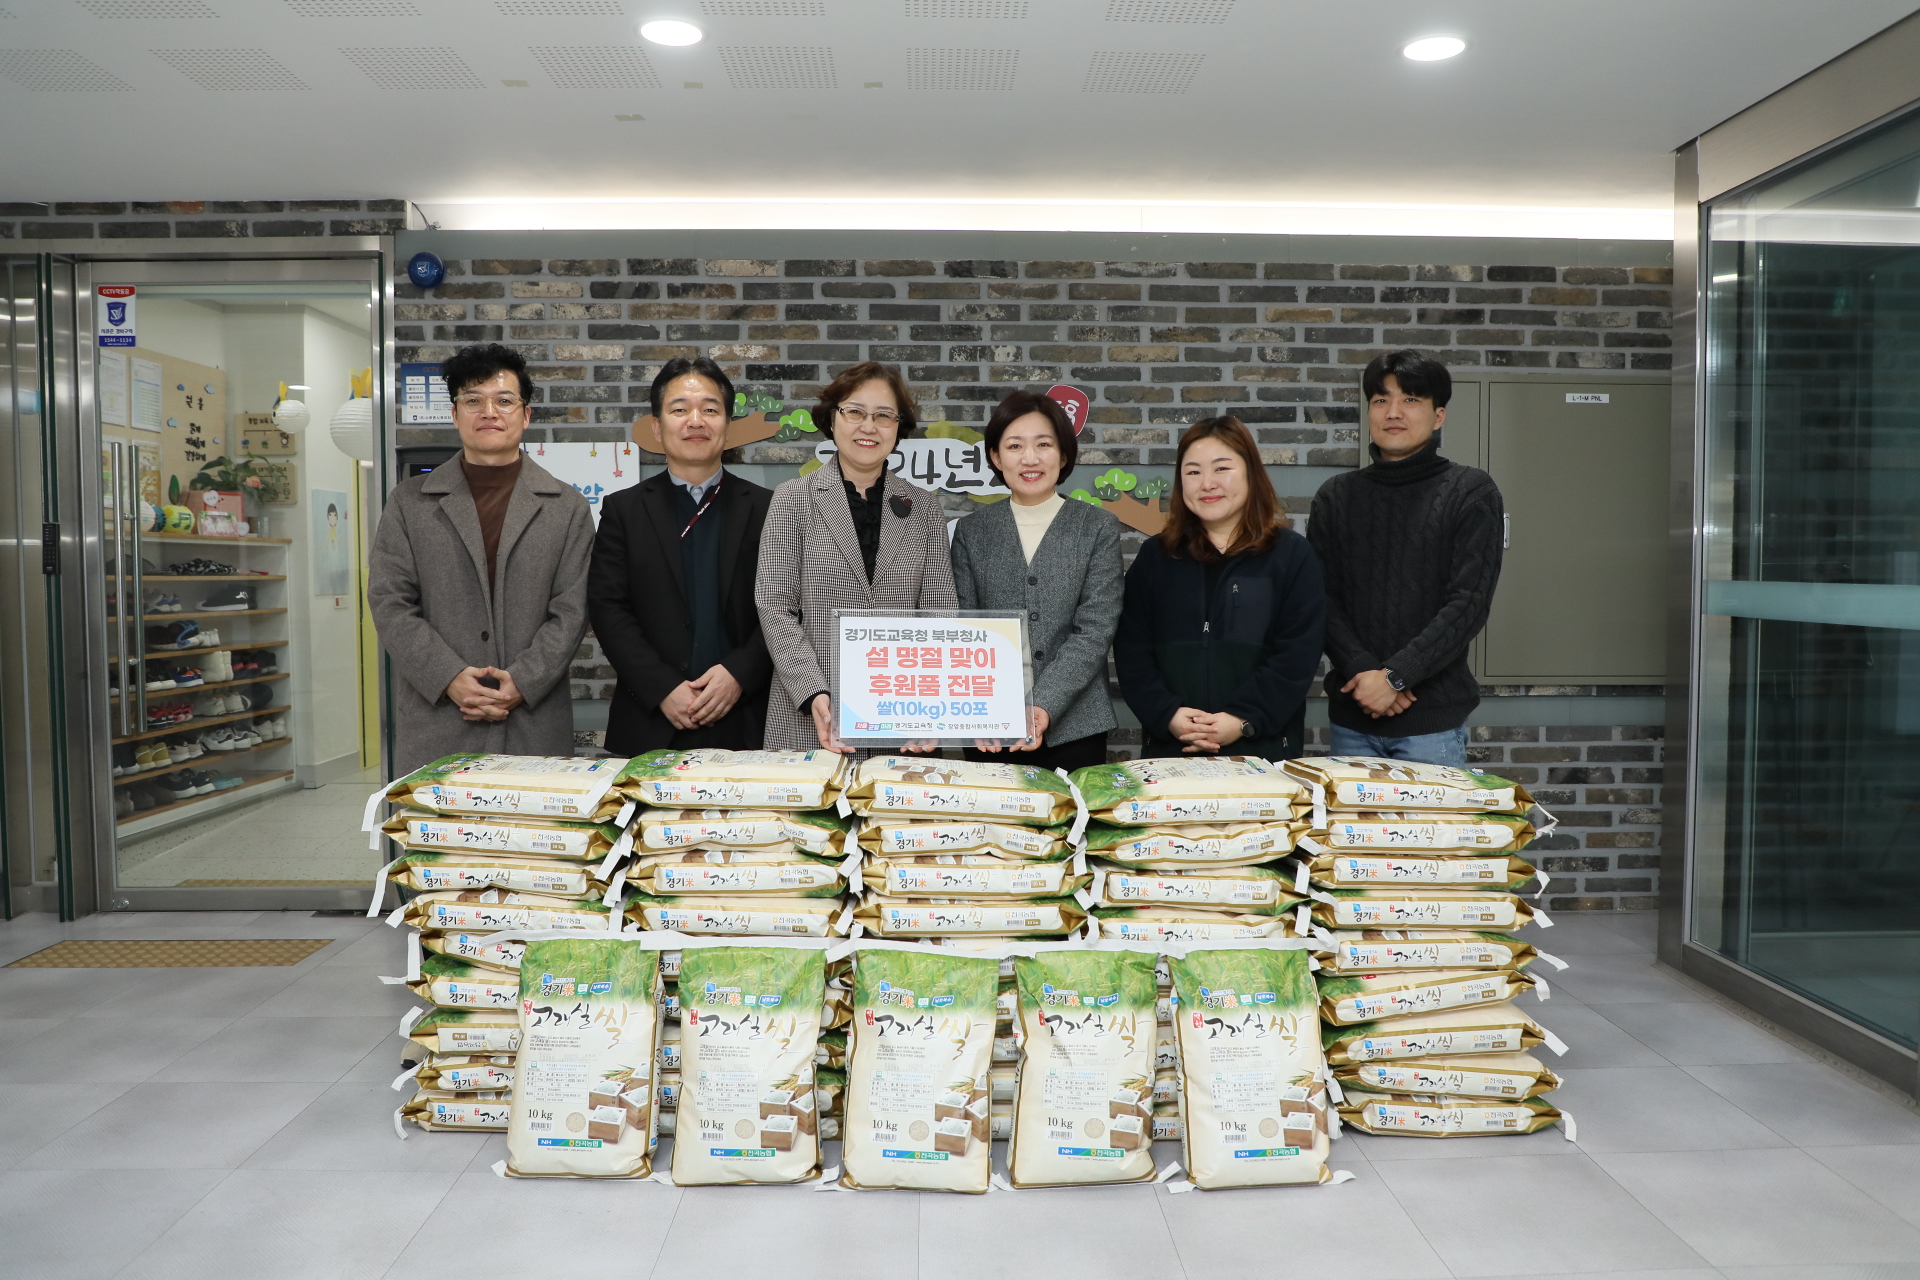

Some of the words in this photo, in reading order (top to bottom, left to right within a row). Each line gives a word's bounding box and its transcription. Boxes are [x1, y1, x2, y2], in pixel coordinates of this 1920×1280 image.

[845, 628, 928, 642] 경기도교육청
[932, 629, 988, 643] 북부청사
[866, 647, 888, 668] 설
[896, 647, 943, 668] 명절
[949, 648, 996, 669] 맞이
[868, 674, 940, 696] 후원품
[948, 675, 996, 697] 전달
[877, 701, 947, 719] 쌀(10kg)
[950, 702, 988, 716] 50포
[541, 983, 574, 997] 경기米
[705, 992, 741, 1005] 경기米
[879, 991, 914, 1008] 경기米
[1044, 993, 1080, 1006] 경기米
[1204, 996, 1237, 1009] 경기米
